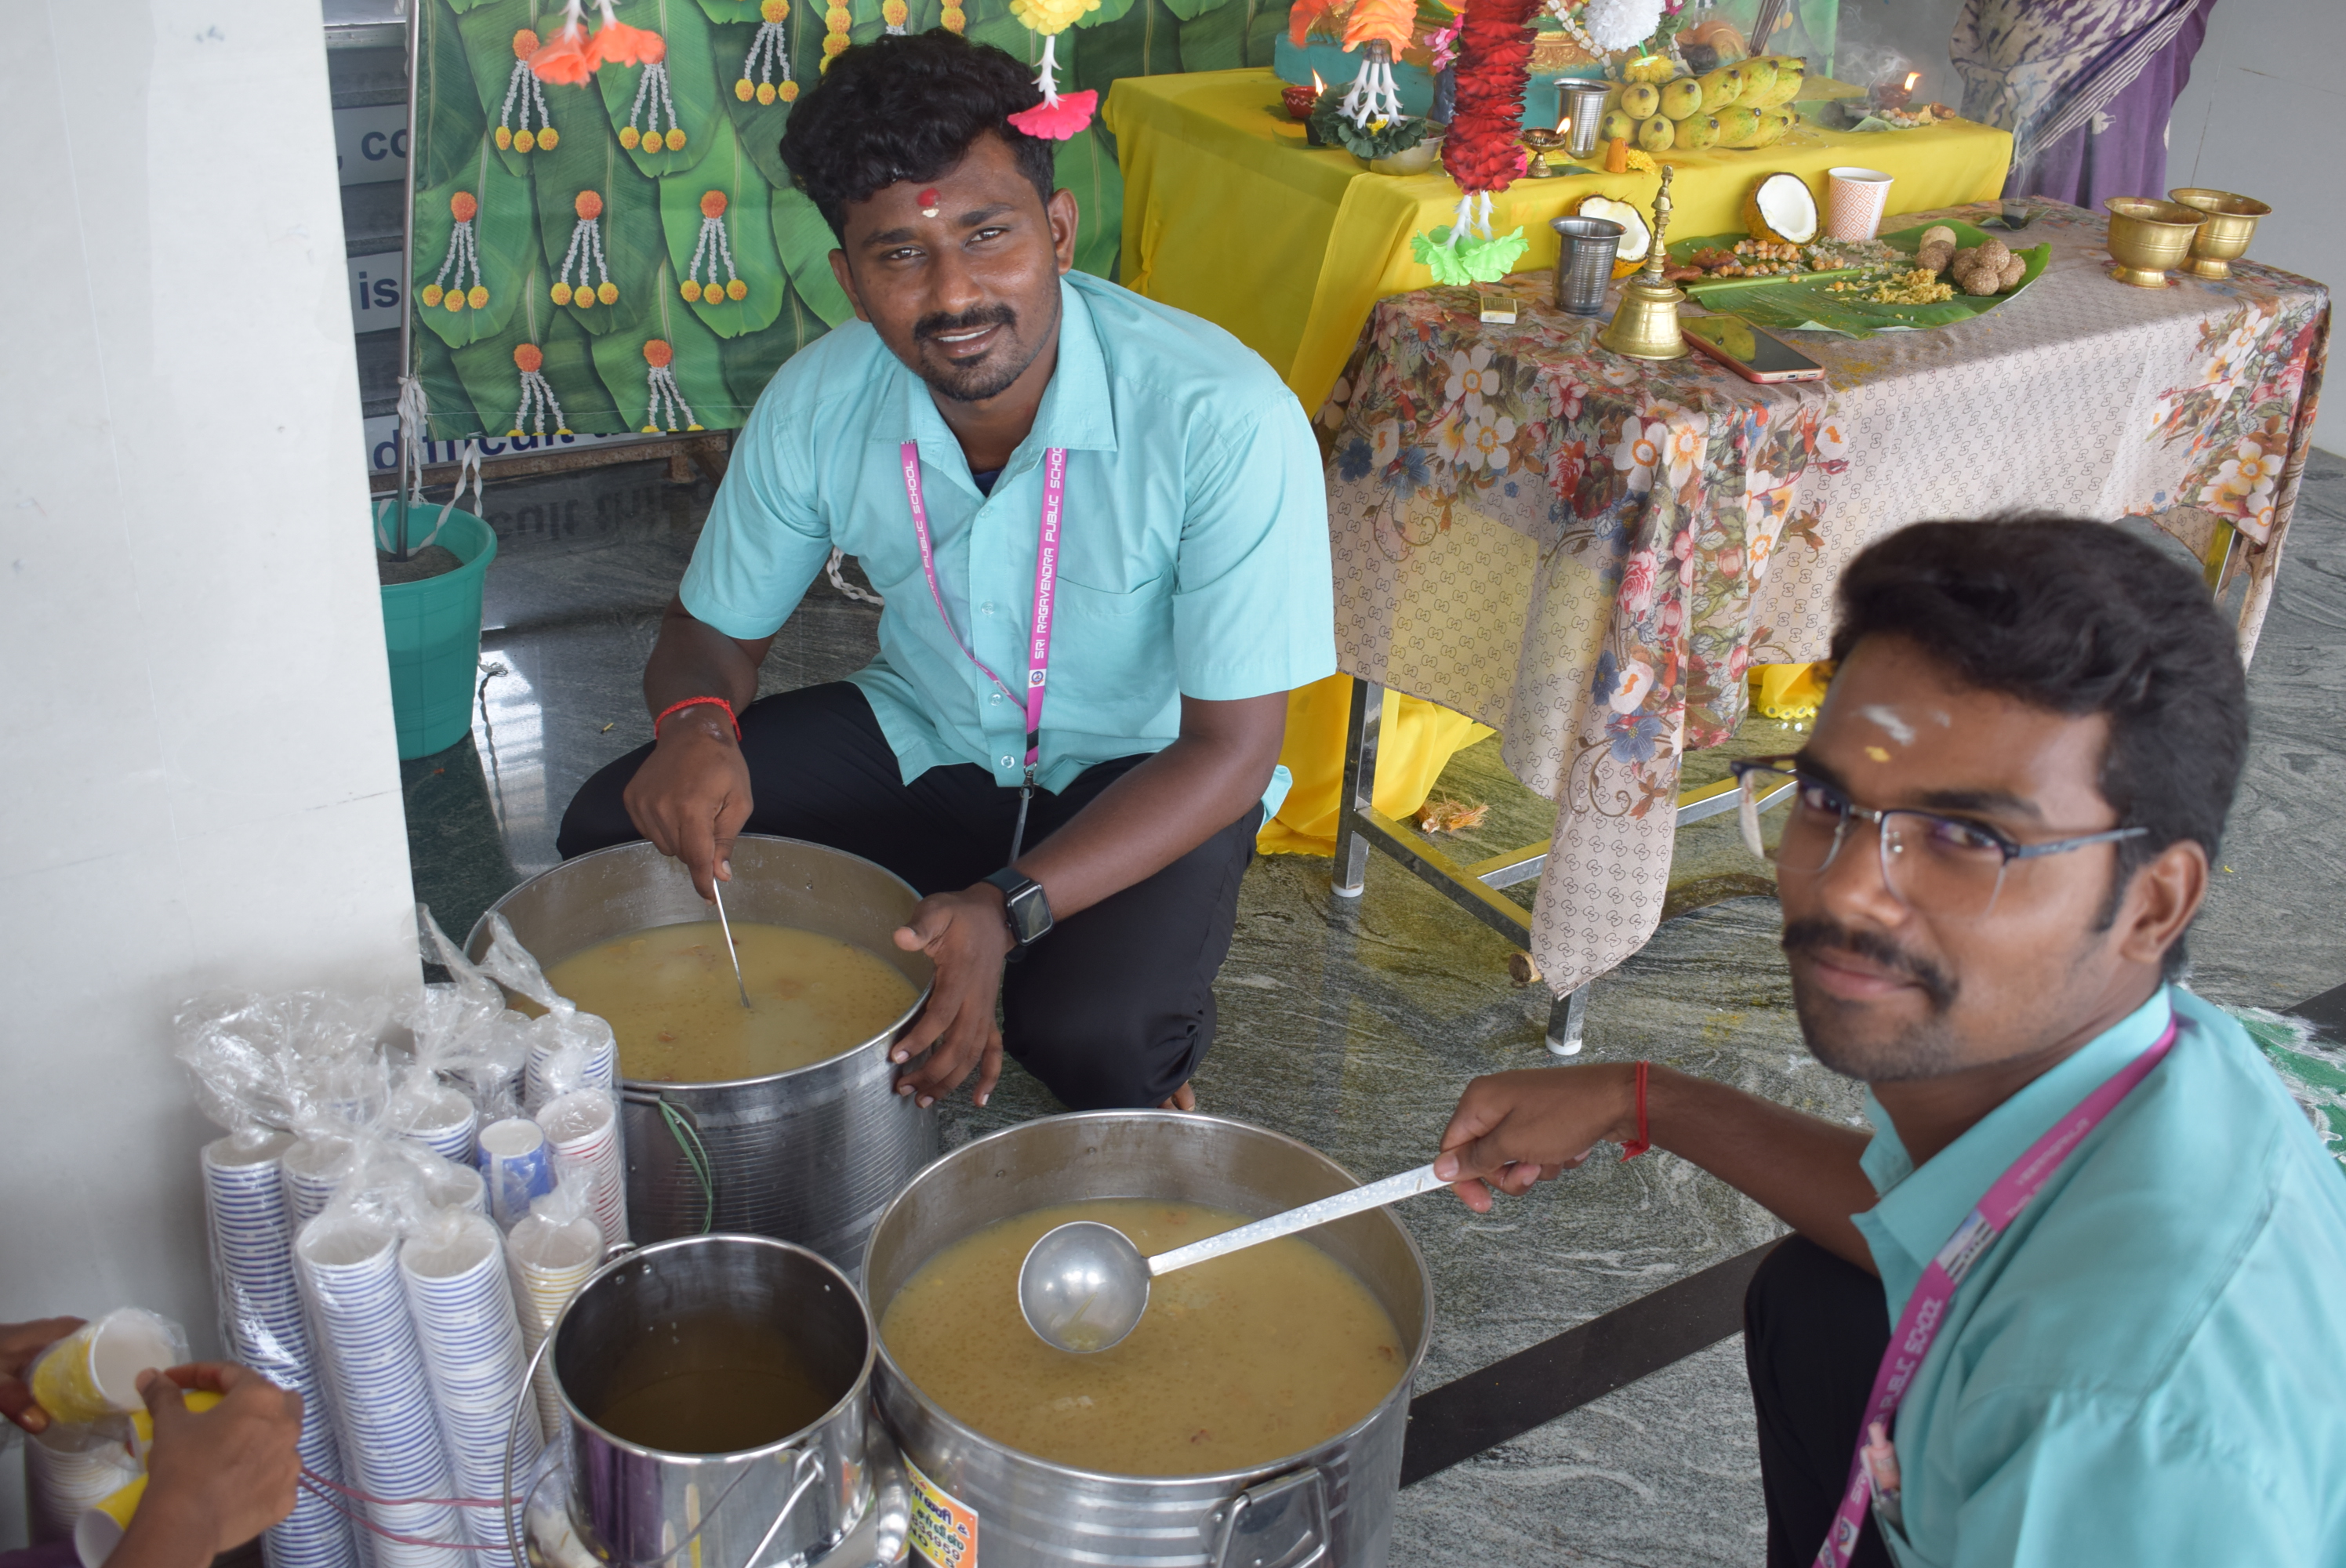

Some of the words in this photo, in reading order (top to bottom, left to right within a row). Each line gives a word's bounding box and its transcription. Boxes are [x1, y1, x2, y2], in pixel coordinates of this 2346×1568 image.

[358, 271, 400, 310] is
[905, 460, 921, 514] SCHOOL
[1044, 494, 1059, 543] PUBLIC
[916, 521, 930, 568] PUBLIC
[1037, 547, 1055, 633] RAGAVENDRA
[1034, 639, 1046, 659] SRI
[1903, 1296, 1943, 1355] SCHOOL
